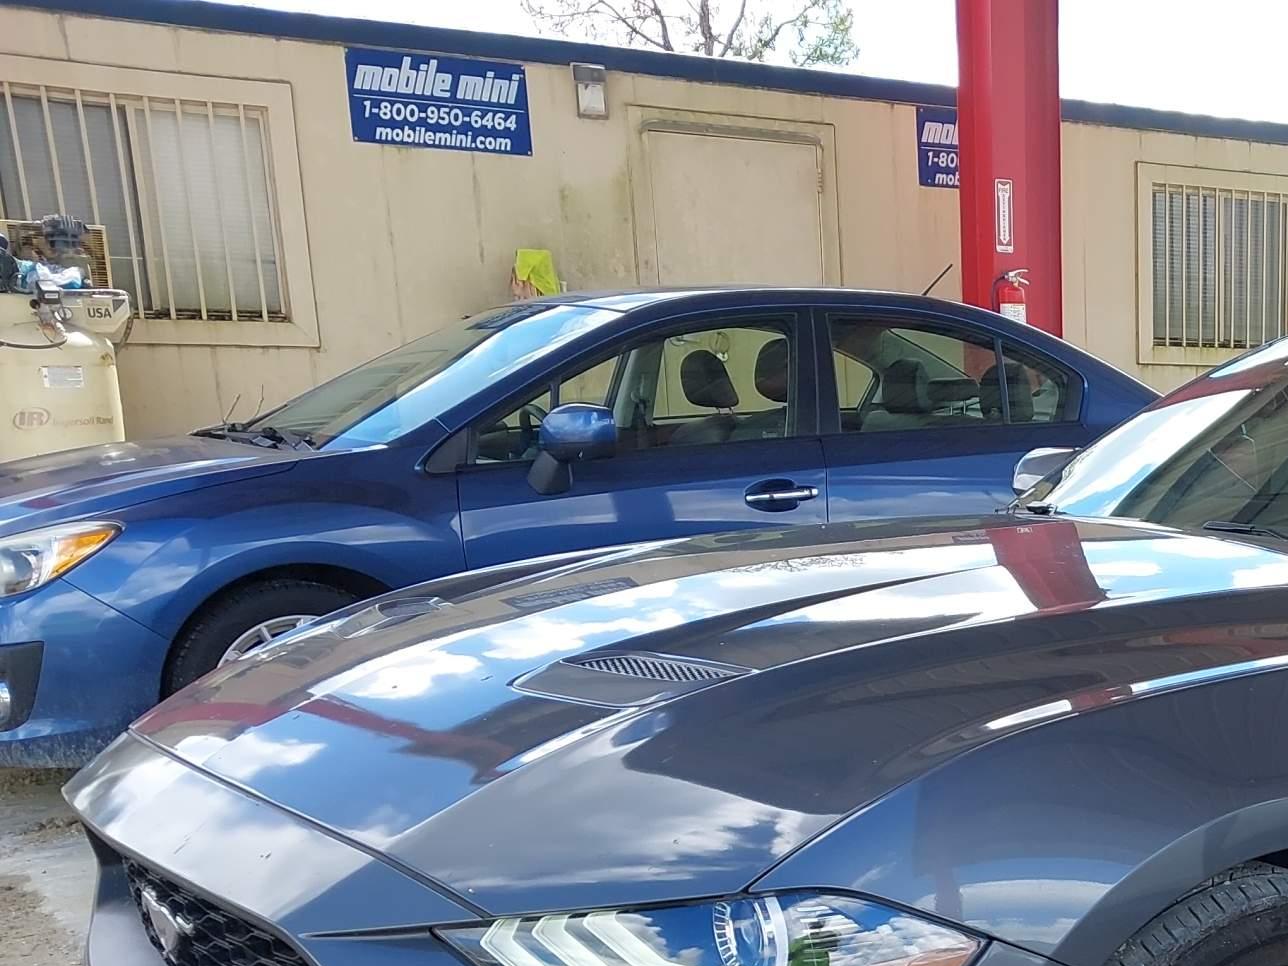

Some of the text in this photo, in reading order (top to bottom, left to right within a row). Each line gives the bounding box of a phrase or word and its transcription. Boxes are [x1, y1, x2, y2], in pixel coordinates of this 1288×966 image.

[354, 56, 520, 104] mobile mini
[363, 101, 517, 131] 1-800-950-6464
[375, 125, 511, 152] mobilemini.com
[927, 151, 959, 168] 1-80
[87, 307, 112, 319] USA
